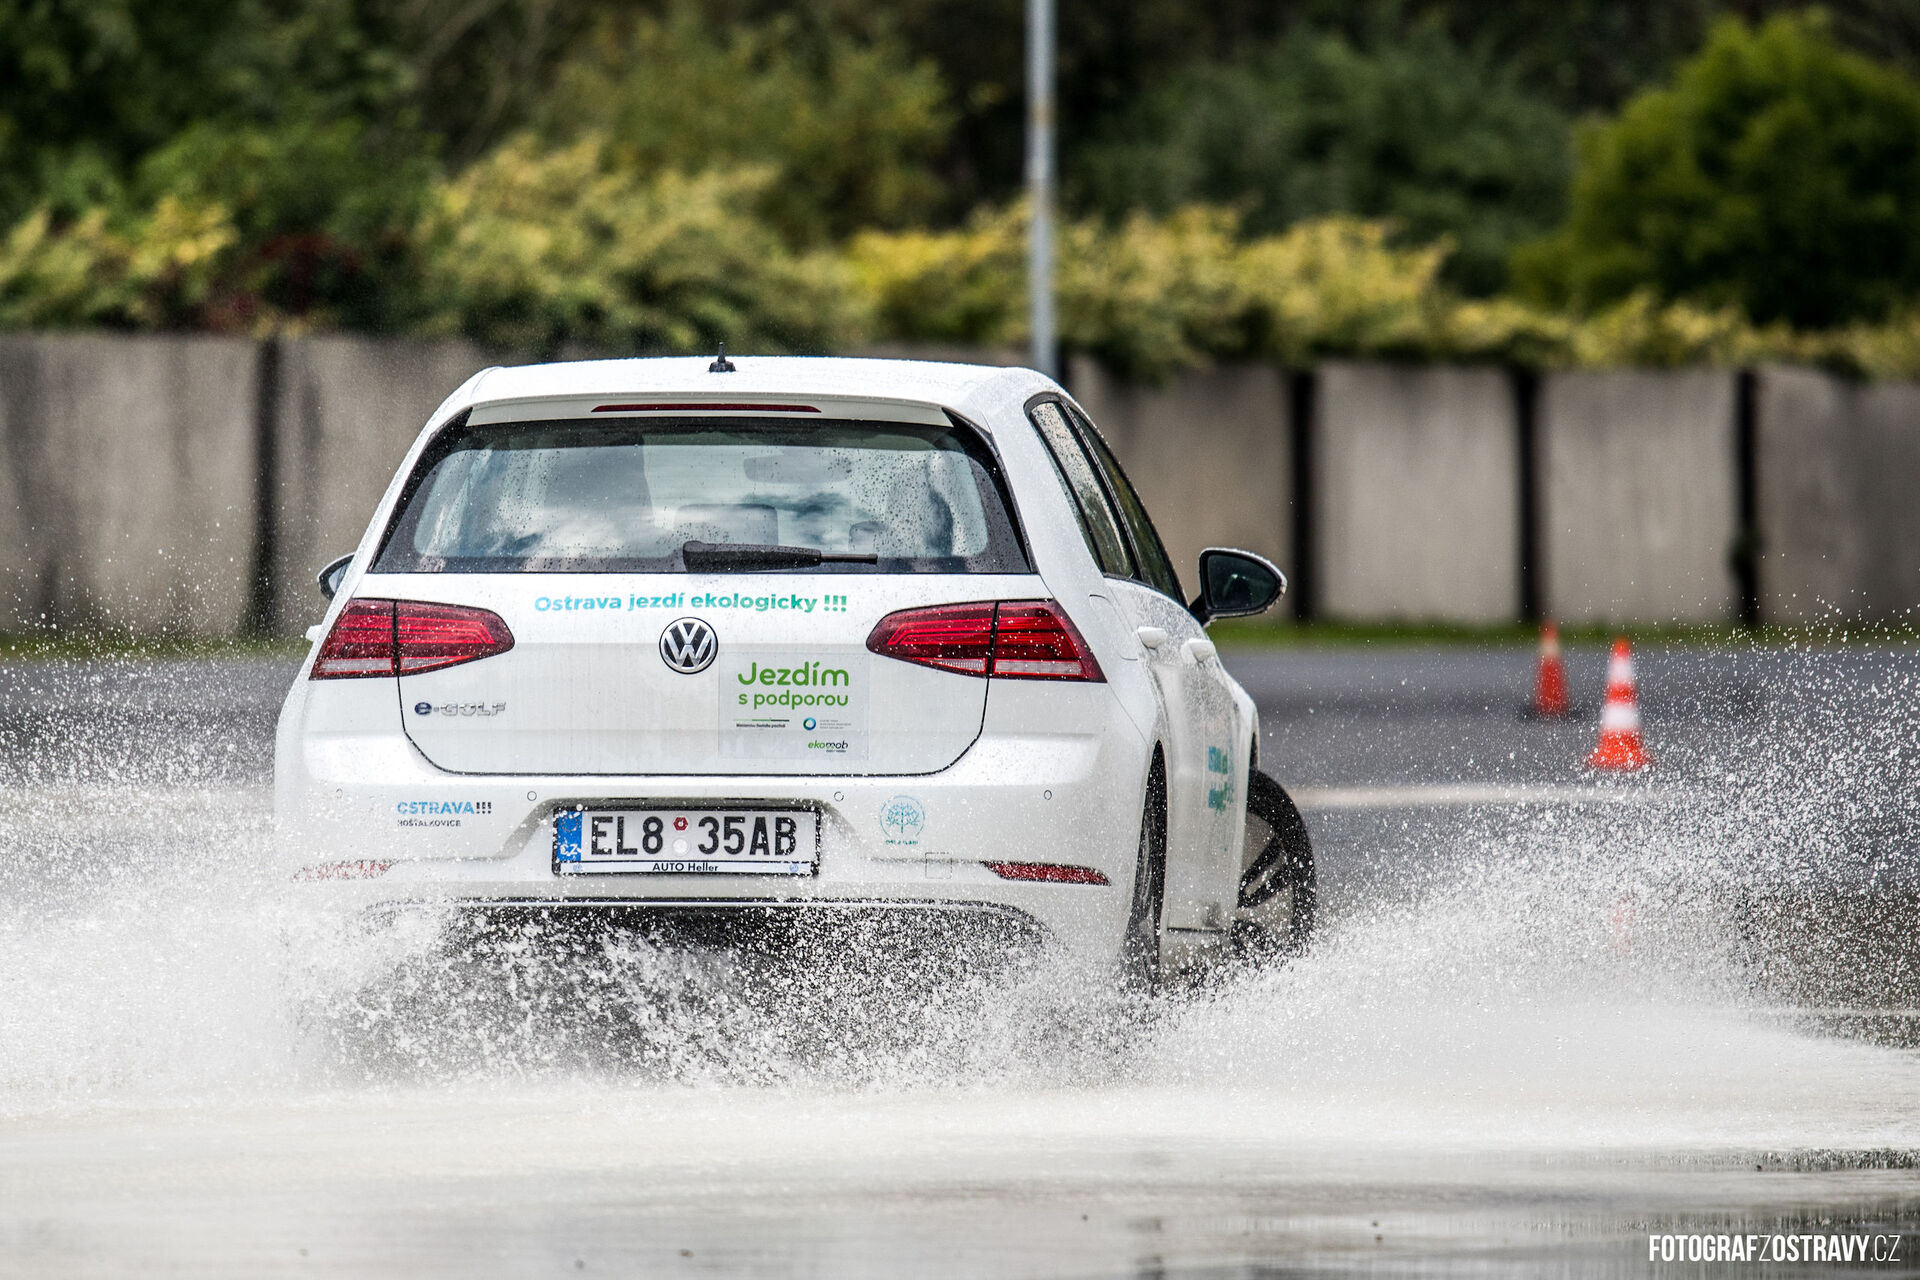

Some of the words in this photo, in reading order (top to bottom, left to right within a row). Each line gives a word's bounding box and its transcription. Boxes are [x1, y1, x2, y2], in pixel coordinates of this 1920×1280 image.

[535, 594, 622, 612] Ostrava
[627, 592, 686, 612] jezdí
[690, 593, 818, 613] ekologicky
[824, 594, 848, 612] !!!
[737, 661, 850, 687] Jezdím
[738, 693, 749, 705] s
[753, 689, 849, 710] podporou
[807, 740, 849, 750] ekomob
[591, 815, 664, 855] EL8
[697, 815, 797, 856] 35AB
[652, 862, 685, 872] AUTO
[687, 861, 719, 872] Heller
